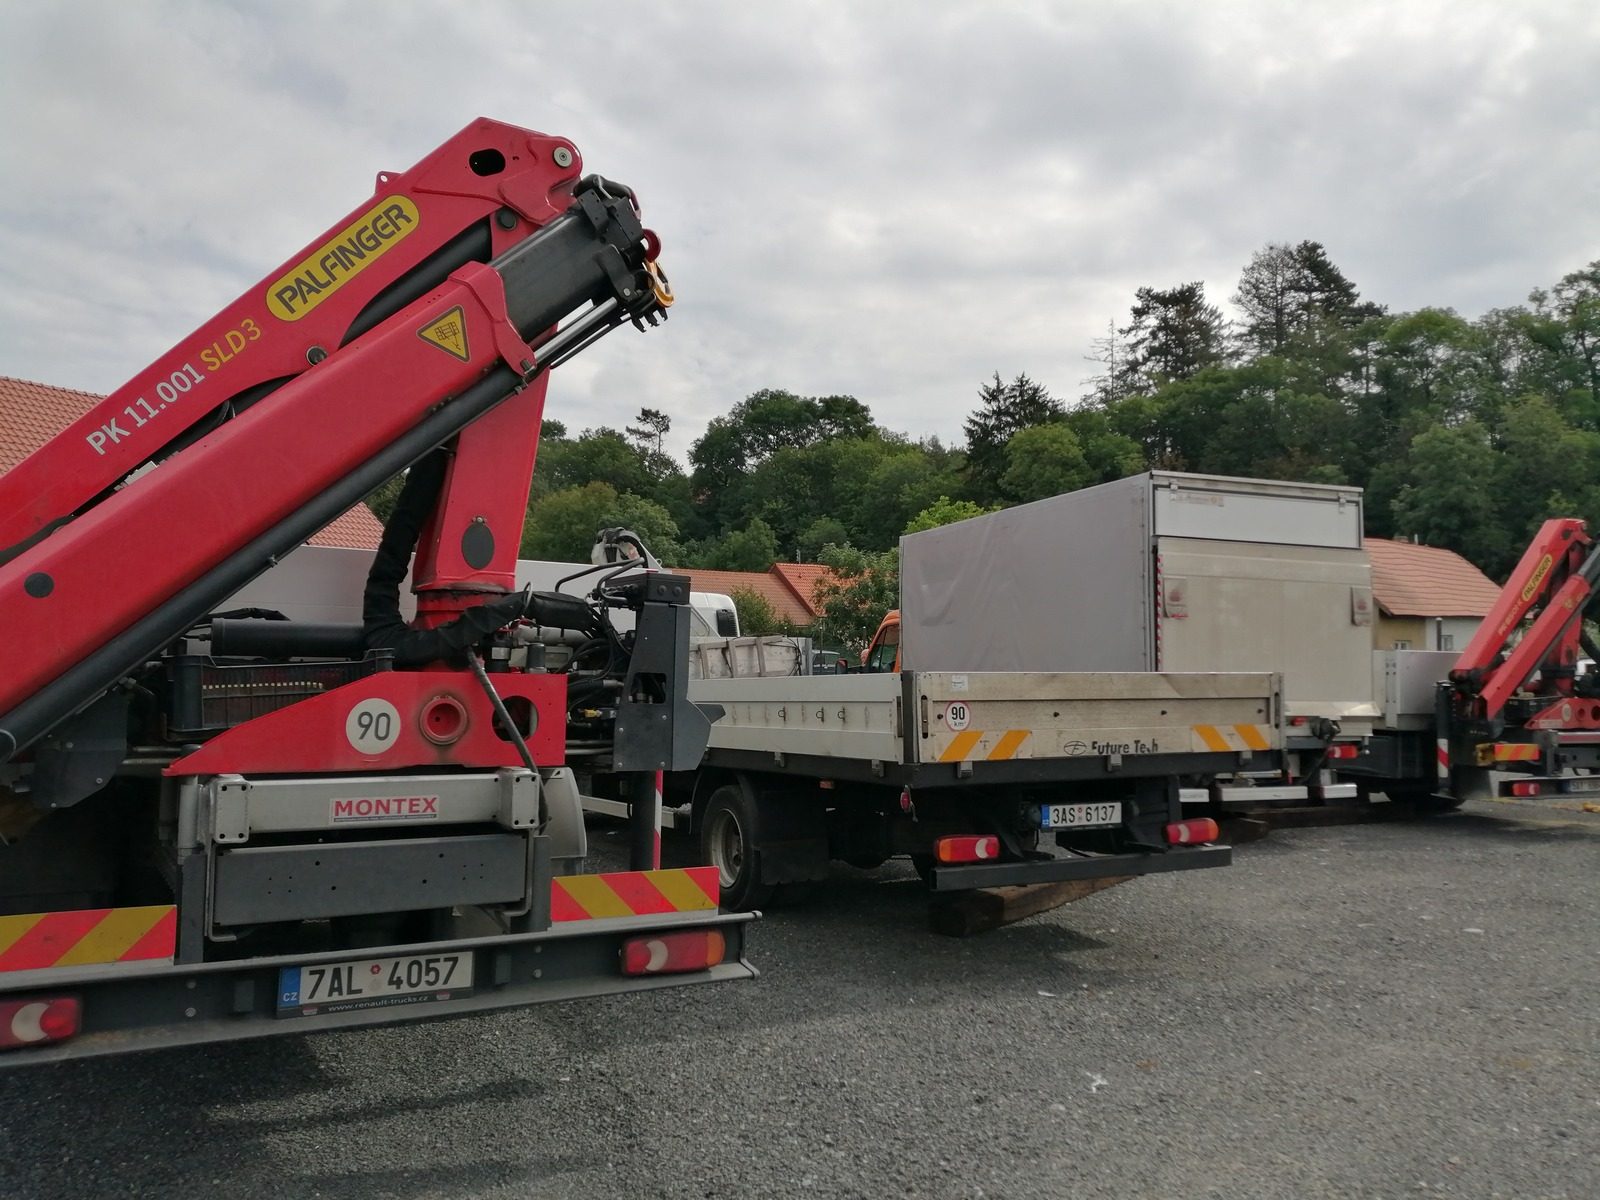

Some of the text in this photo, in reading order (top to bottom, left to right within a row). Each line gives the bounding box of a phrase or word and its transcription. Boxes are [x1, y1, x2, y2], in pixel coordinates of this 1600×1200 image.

[274, 203, 413, 314] PALFINGER
[85, 417, 131, 455] PK
[123, 363, 205, 428] 11.001
[951, 706, 965, 720] 90
[358, 711, 391, 741] 90
[335, 797, 437, 816] MONTEX
[1053, 806, 1115, 824] 3AS 6137
[308, 956, 459, 1000] 7AL 4057
[283, 992, 298, 1002] CZ
[328, 995, 429, 1012] www.renault-trucks.cz
